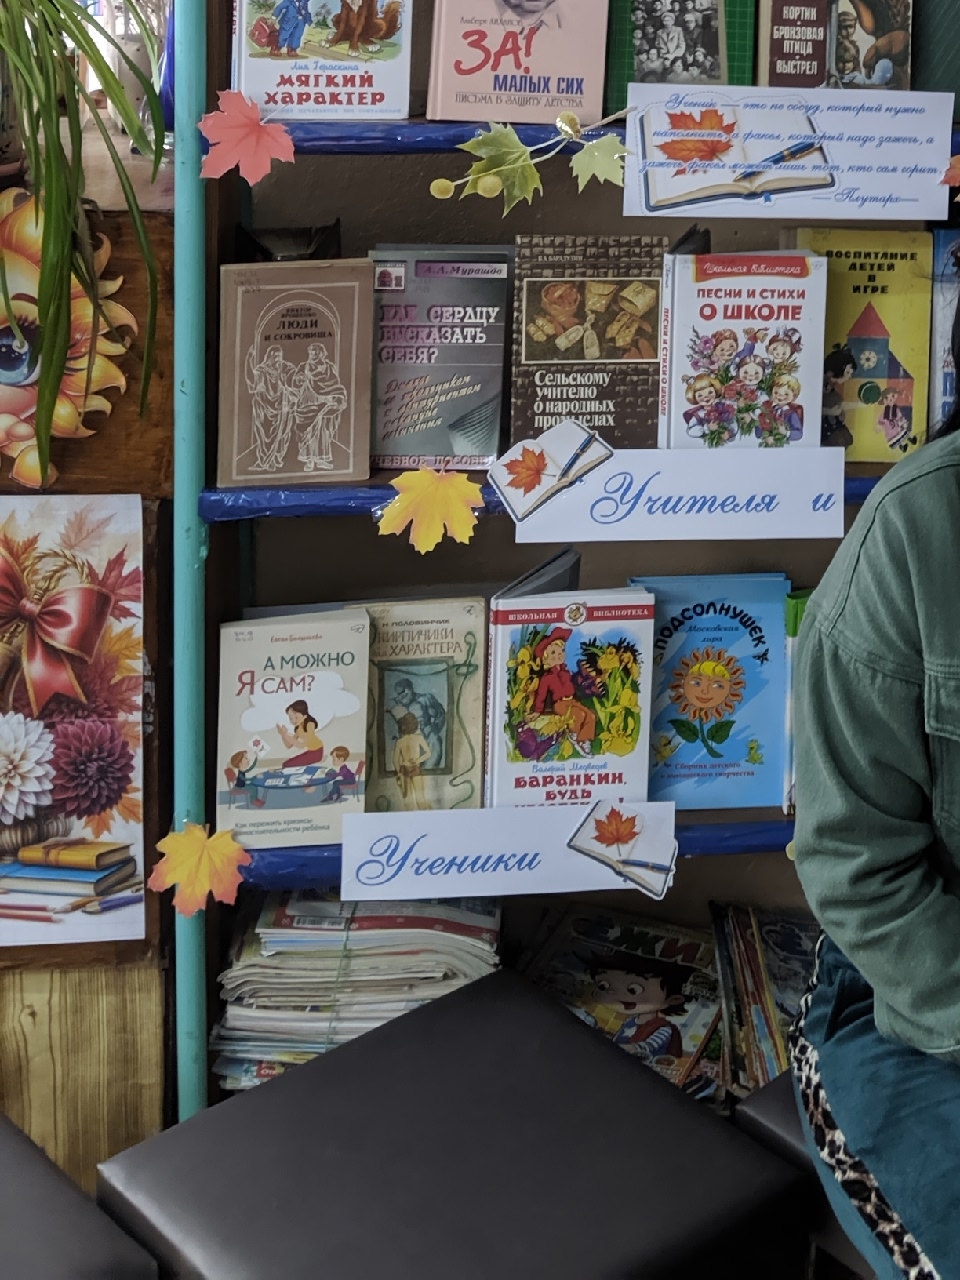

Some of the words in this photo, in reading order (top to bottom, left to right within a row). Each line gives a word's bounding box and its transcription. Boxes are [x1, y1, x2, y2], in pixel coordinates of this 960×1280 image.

[783, 6, 817, 21] КОРТИК
[773, 25, 824, 41] БРОНЗОВАЯ
[453, 26, 538, 76] ЗА!
[783, 39, 813, 55] ПТИЦА
[776, 59, 818, 76] ВЫСТРЕЛ
[492, 73, 552, 94] МАЛЫХ
[556, 76, 585, 96] СИХ
[665, 93, 718, 110] Ученик
[742, 103, 766, 112] это
[769, 104, 785, 112] не
[826, 103, 881, 117] который
[883, 105, 926, 119] нужно
[788, 132, 845, 146] который
[846, 134, 874, 146] надо
[686, 160, 726, 173] факел
[728, 162, 773, 171] может
[847, 165, 872, 173] кто
[834, 187, 902, 208] Плутарх
[825, 249, 918, 262] ВОСПИТАНИЕ
[848, 262, 896, 273] ДЕТЕЙ
[868, 274, 876, 283] В
[696, 287, 741, 300] ПЕСНИ
[746, 288, 756, 300] И
[759, 288, 806, 301] СТИХИ
[852, 284, 889, 294] ИГРЕ
[381, 304, 418, 323] КАК
[429, 305, 500, 327] СЕРДЦУ
[699, 303, 719, 321] О
[723, 304, 803, 321] ШКОЛЕ
[276, 319, 319, 330] ЛЮДИ
[273, 330, 333, 341] СОКРОВИЩА
[381, 326, 487, 344] ВЫСКАЗАТЬ
[380, 346, 439, 364] СЕБЯ?
[533, 370, 612, 388] Сельскому
[535, 387, 598, 402] учителю
[533, 402, 542, 412] о
[545, 400, 616, 416] народных
[589, 470, 780, 525] Учителя
[812, 492, 836, 512] и
[507, 611, 558, 622] ШКОЛЬНАЯ
[592, 607, 649, 618] БИБЛИОТЕКА
[653, 600, 768, 655] ПОДСОЛНУШЕК
[377, 628, 455, 645] КИРПИЧИКИ
[388, 641, 464, 657] ХАРАКТЕРА
[263, 656, 276, 671] А
[280, 651, 356, 671] МОЖНО
[235, 670, 256, 697] Я
[260, 674, 316, 695] САМ?
[544, 788, 592, 802] БУДЬ
[355, 833, 542, 887] Ученики
